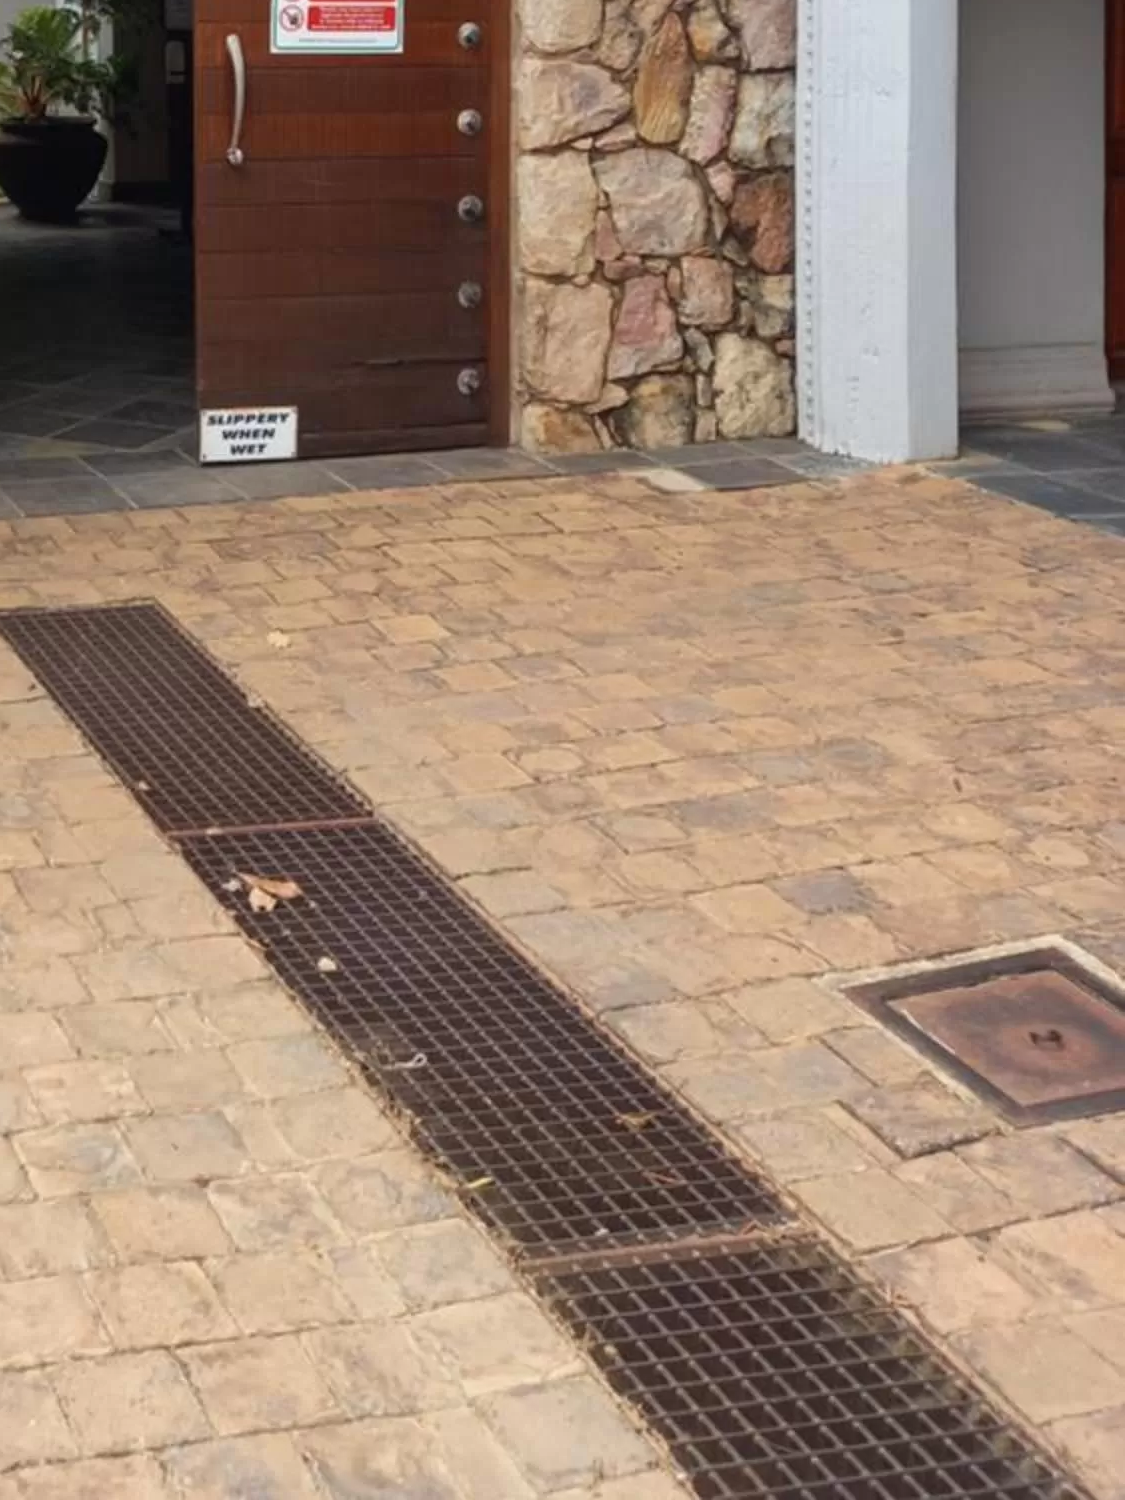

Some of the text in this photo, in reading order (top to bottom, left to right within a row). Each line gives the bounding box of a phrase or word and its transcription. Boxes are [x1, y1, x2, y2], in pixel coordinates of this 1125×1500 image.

[207, 412, 289, 425] SLIPPERY
[221, 427, 276, 440] WHEN
[230, 443, 268, 455] WET
